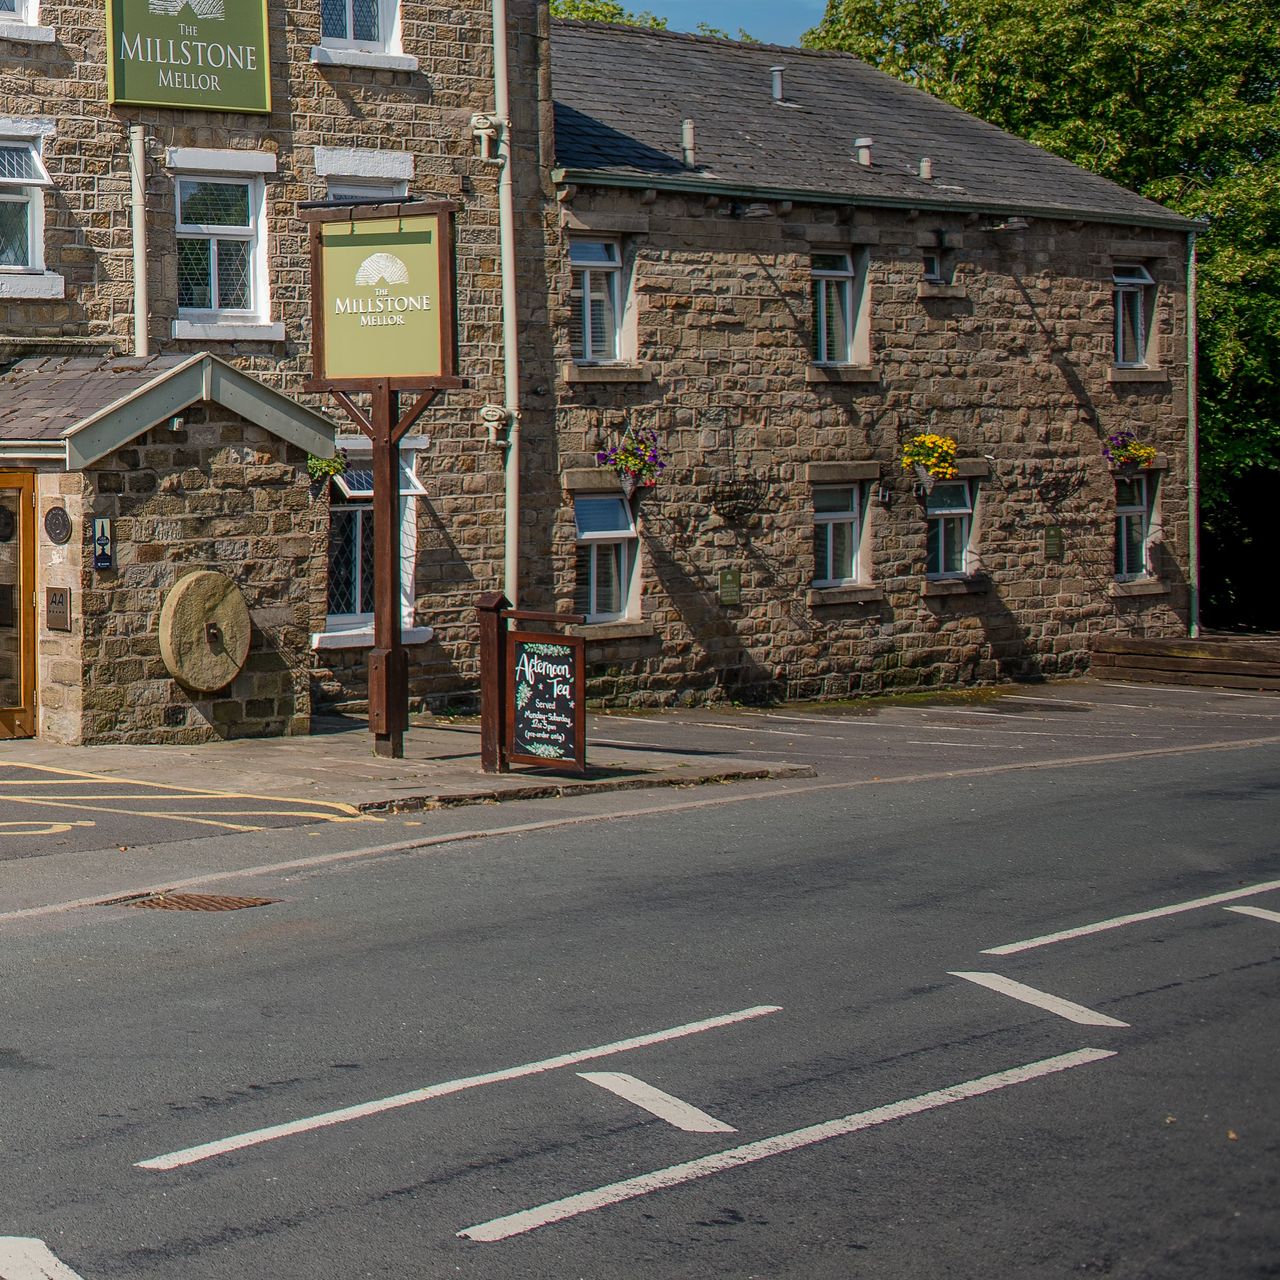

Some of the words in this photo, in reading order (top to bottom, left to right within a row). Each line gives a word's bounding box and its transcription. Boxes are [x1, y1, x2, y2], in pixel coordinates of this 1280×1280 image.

[178, 23, 198, 36] THE
[119, 31, 257, 70] MILLSTONE
[158, 69, 222, 91] MELLOR
[374, 288, 389, 296] THE
[335, 295, 431, 314] MILLSTONE
[360, 314, 405, 326] MELLOR
[50, 592, 64, 606] AA
[515, 653, 571, 685] Afternoon
[546, 677, 571, 699] Tea
[535, 698, 556, 710] Served
